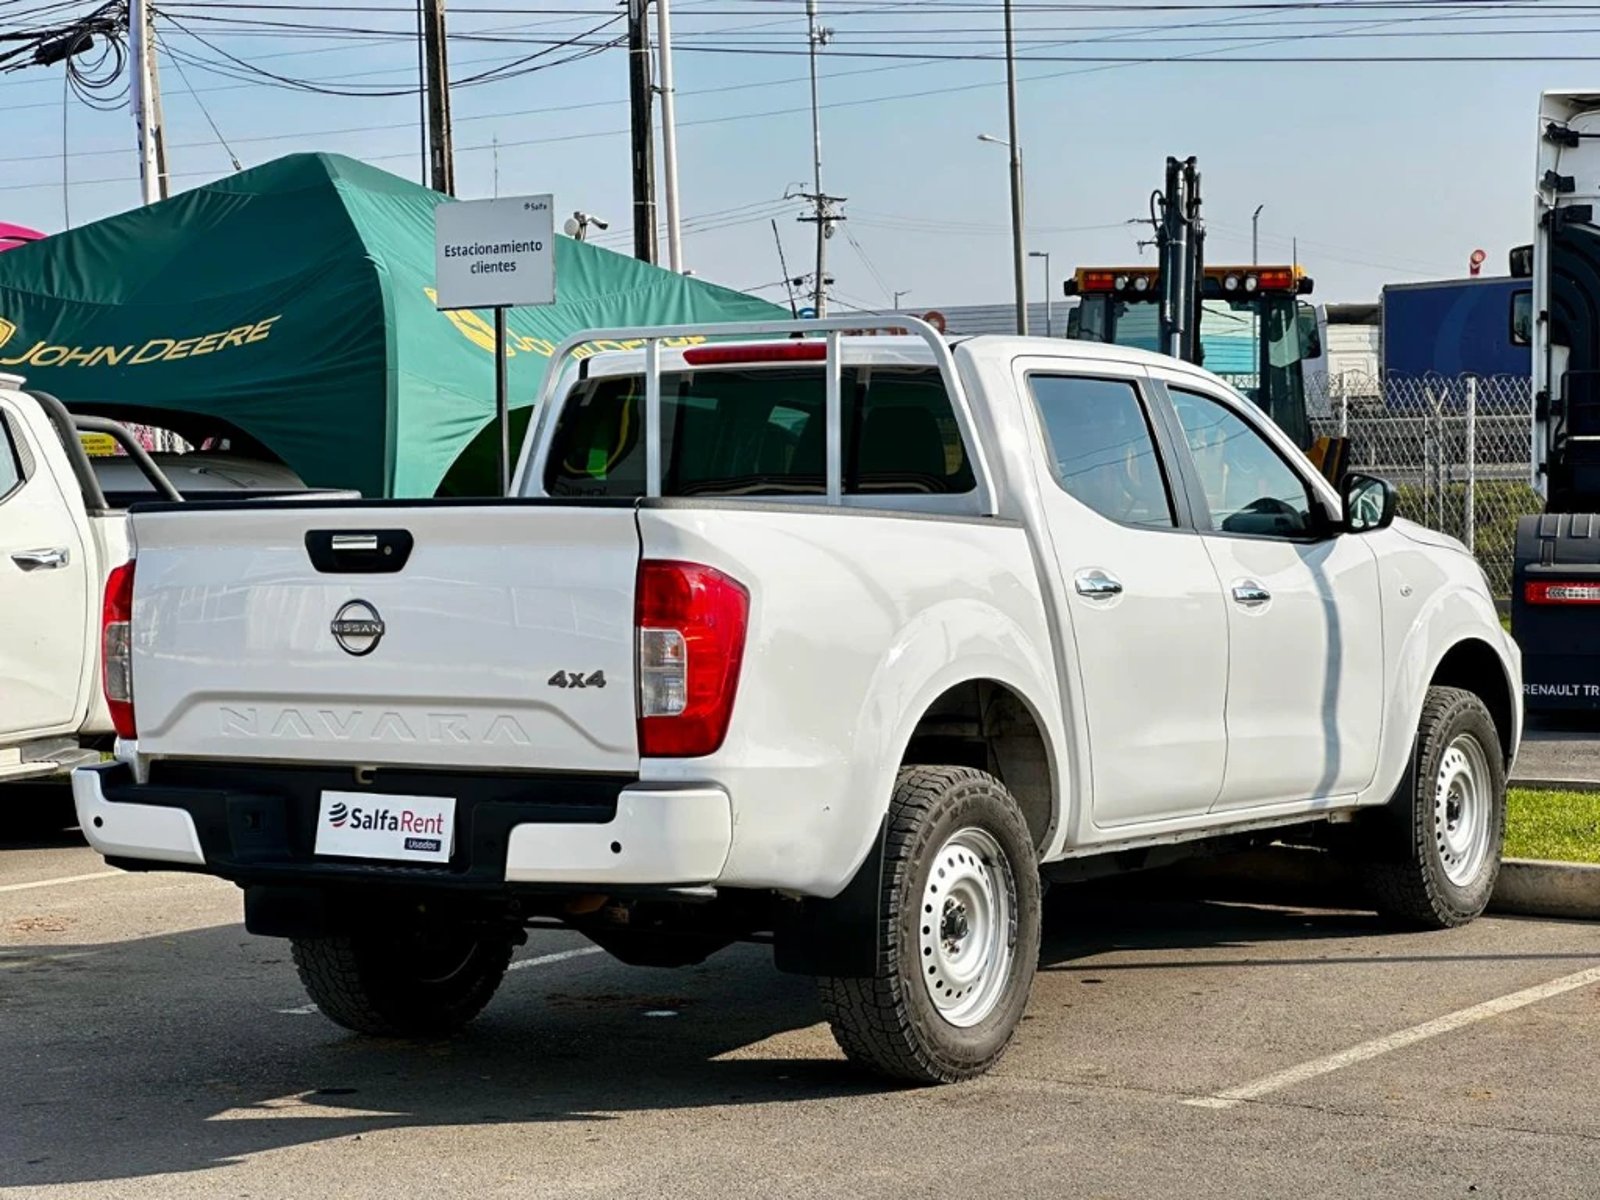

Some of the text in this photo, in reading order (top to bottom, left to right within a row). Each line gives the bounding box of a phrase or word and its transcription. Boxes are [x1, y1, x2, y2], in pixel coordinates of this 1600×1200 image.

[444, 240, 543, 258] Estacionamiento
[470, 260, 517, 274] clientes
[1, 314, 282, 367] JOHN DEERE
[332, 622, 381, 633] NISSAN
[547, 669, 607, 689] 4x4
[1521, 683, 1580, 697] RENAULT
[219, 706, 532, 746] NAVARA
[350, 807, 444, 835] SalfaRent
[408, 840, 437, 850] Usados
